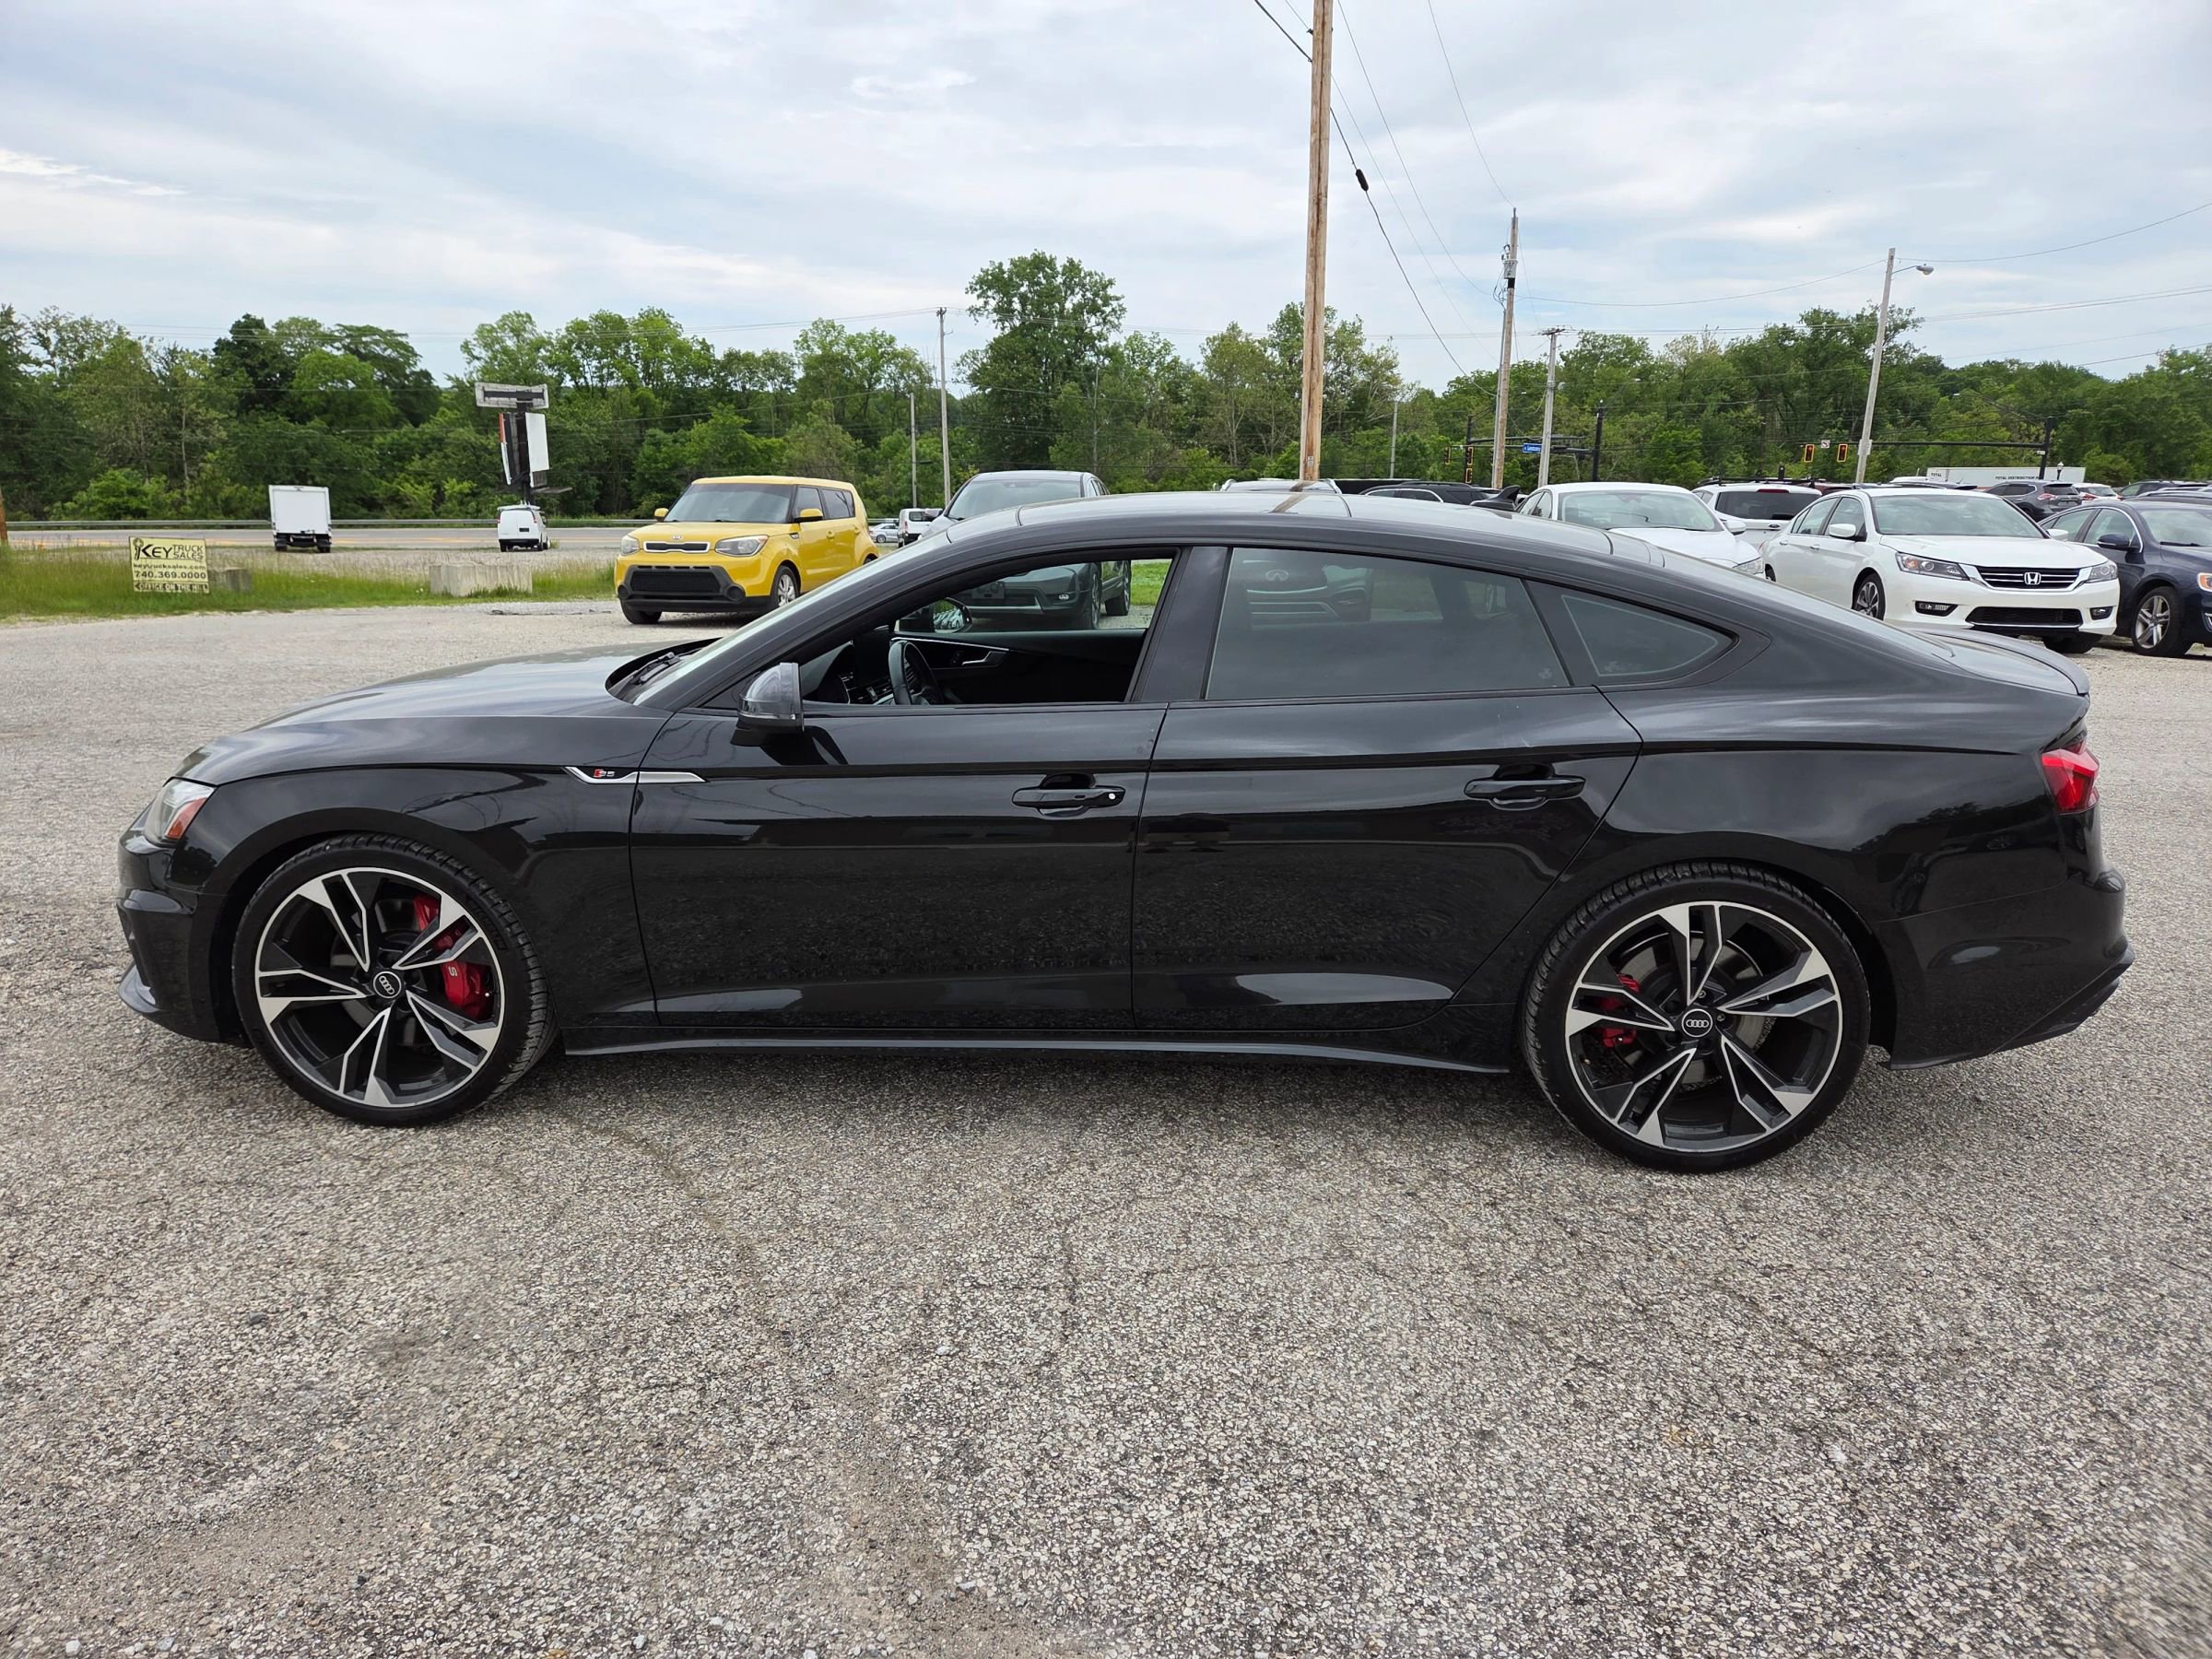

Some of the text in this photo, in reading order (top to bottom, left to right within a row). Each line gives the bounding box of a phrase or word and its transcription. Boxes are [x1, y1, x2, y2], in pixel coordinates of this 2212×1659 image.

[135, 541, 172, 560] KEY
[173, 552, 204, 561] SALES
[135, 571, 206, 579] 740.369.0000
